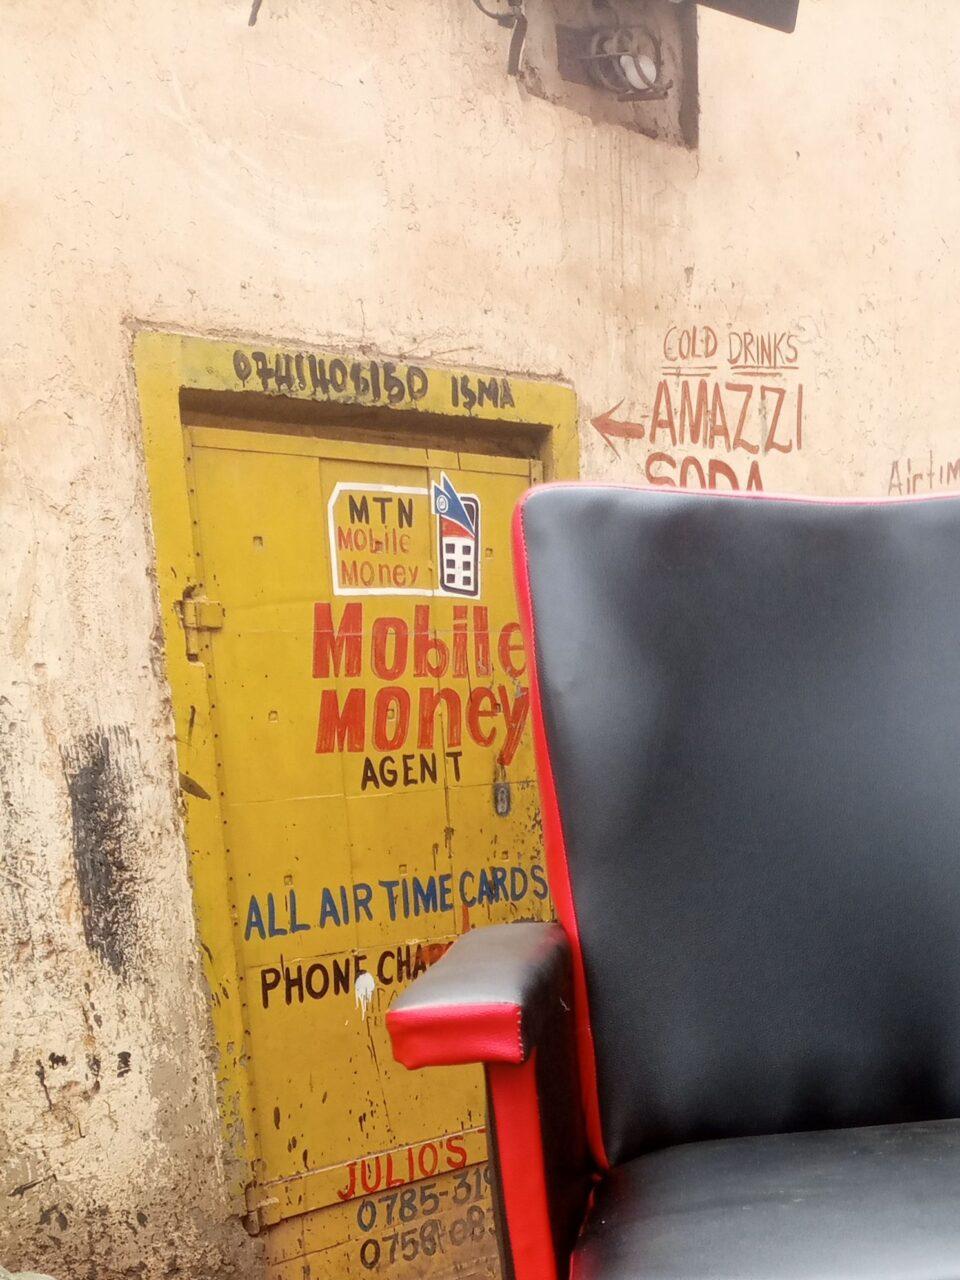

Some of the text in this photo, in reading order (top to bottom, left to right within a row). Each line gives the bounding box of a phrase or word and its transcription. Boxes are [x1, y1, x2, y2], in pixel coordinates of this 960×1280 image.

[664, 325, 799, 368] COLD DRINKS
[450, 374, 515, 410] ISMA
[650, 379, 803, 454] AMAZZI
[348, 495, 413, 528] MTN
[312, 602, 527, 681] Mobile
[315, 684, 530, 766] Money
[361, 751, 463, 791] AGENT
[244, 889, 311, 941] ALL
[459, 864, 549, 909] CARDS
